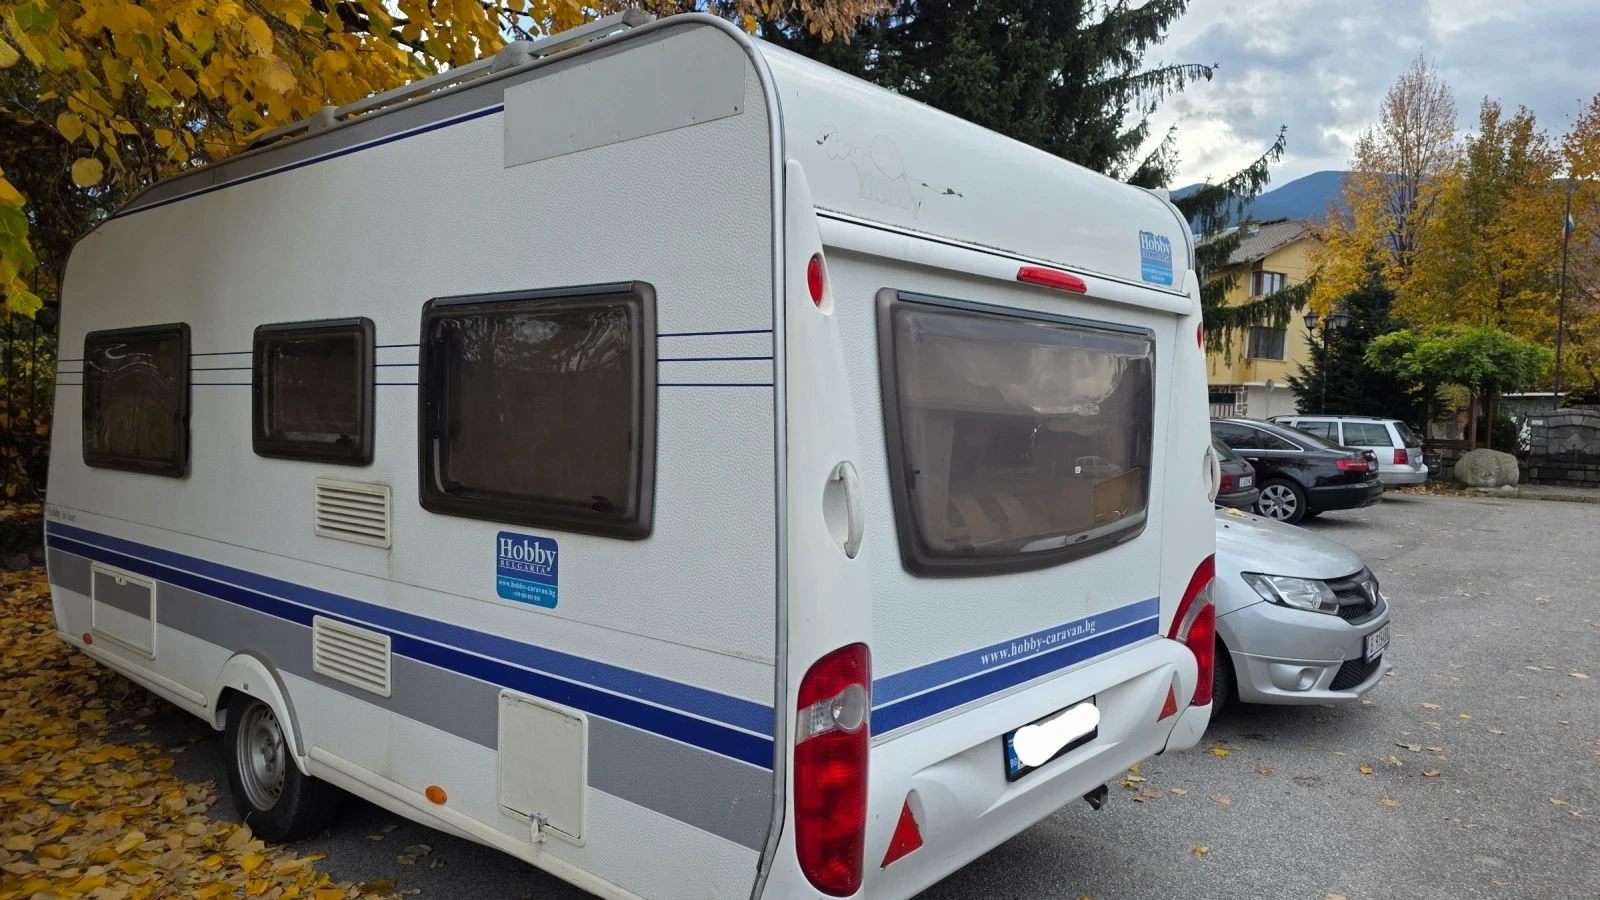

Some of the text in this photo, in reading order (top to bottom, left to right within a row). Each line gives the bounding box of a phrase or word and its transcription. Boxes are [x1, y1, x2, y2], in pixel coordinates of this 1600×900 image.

[1140, 233, 1171, 260] Hobby
[499, 537, 557, 572] Hobby
[500, 560, 546, 574] BULGARIA
[498, 579, 556, 599] www.hobby-caravan.bg
[980, 619, 1096, 665] www.hobby-caravan.bg
[1010, 757, 1018, 769] BG
